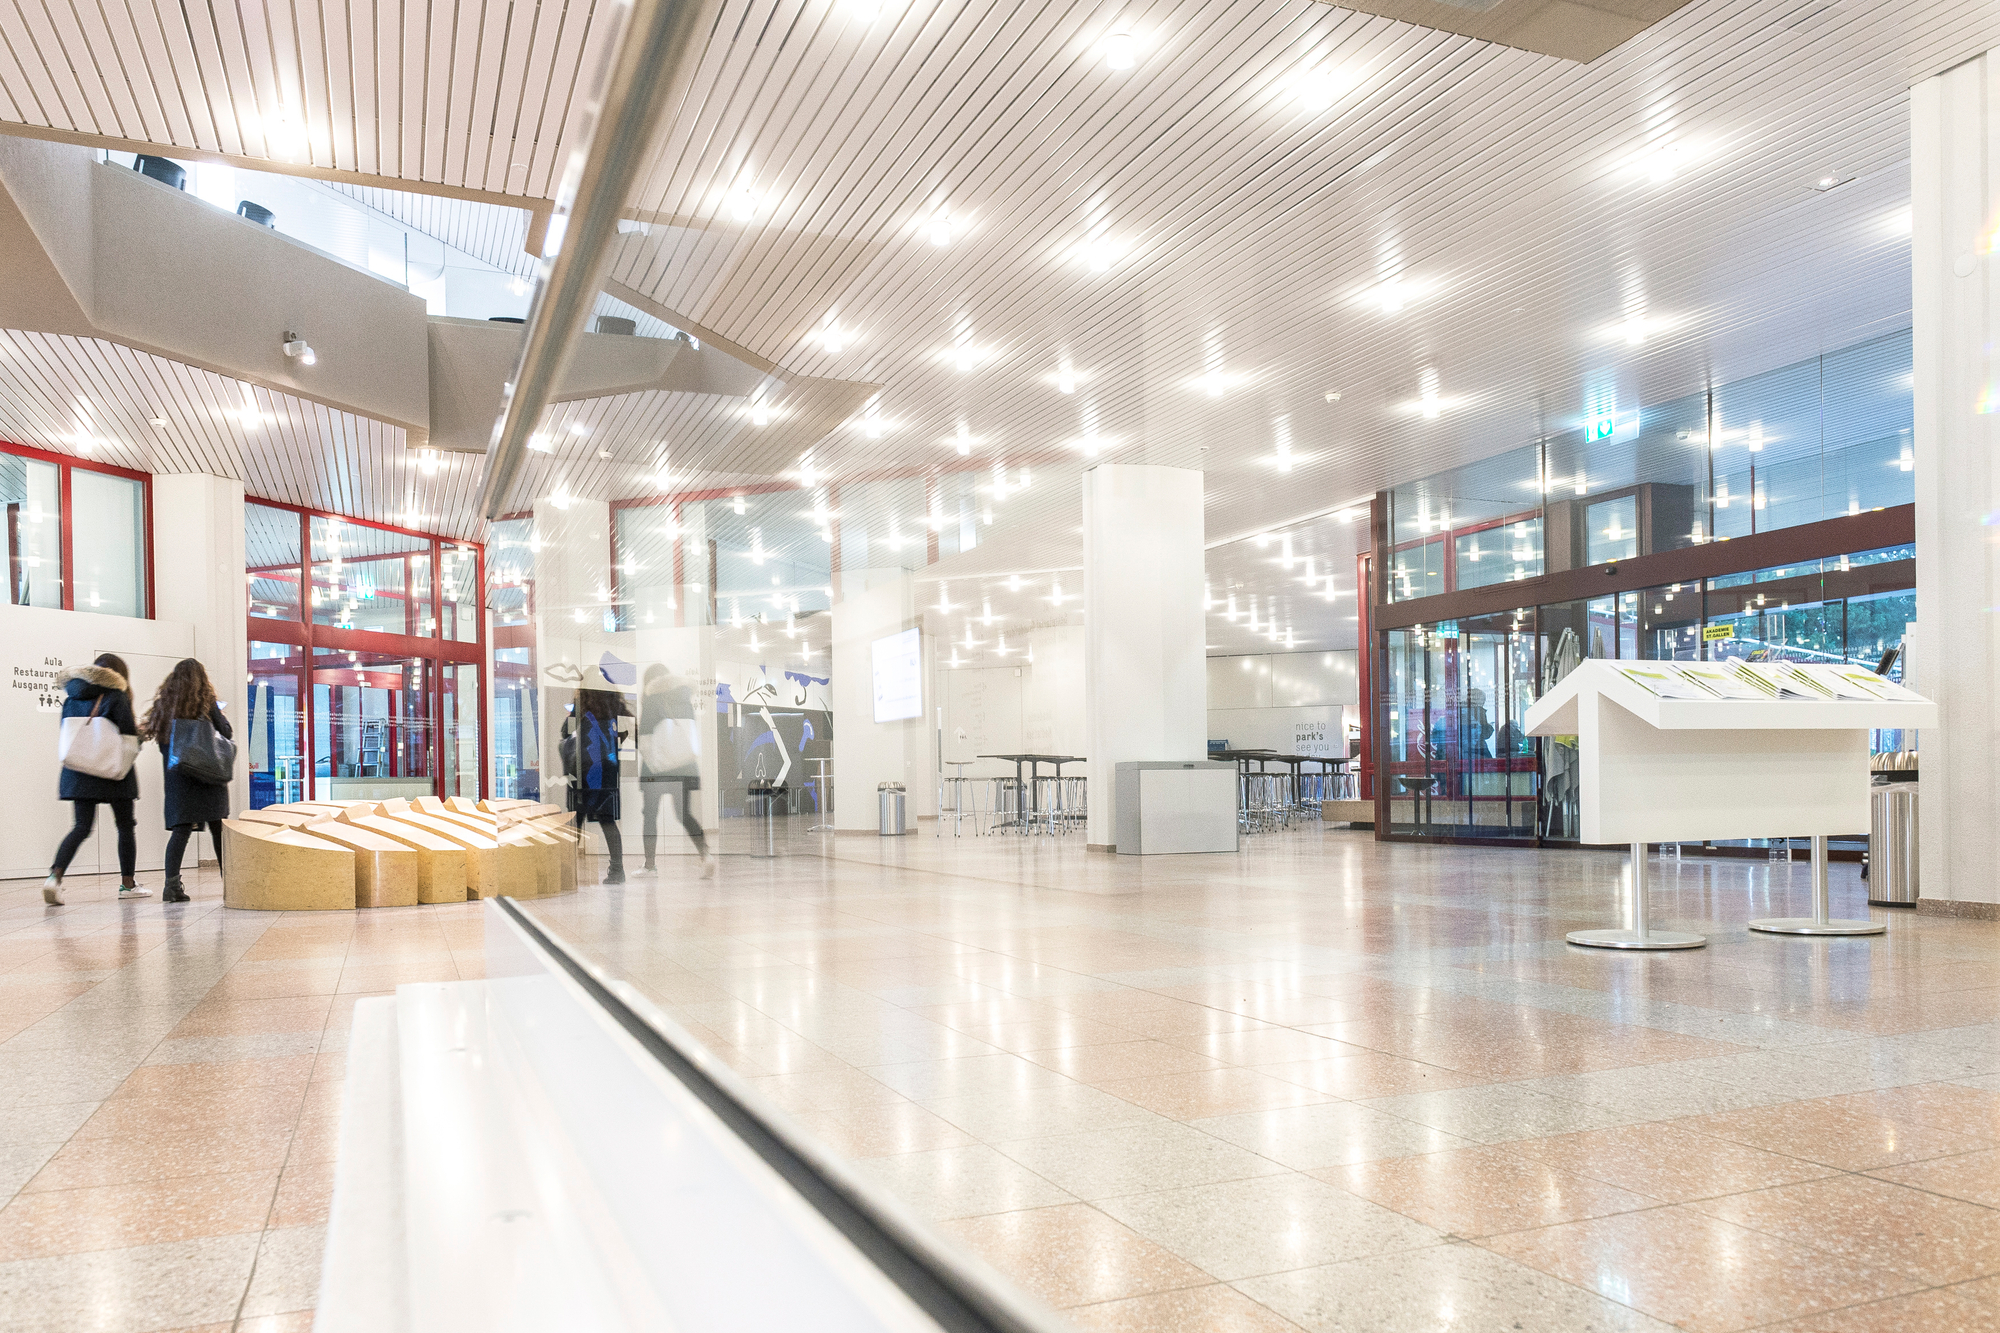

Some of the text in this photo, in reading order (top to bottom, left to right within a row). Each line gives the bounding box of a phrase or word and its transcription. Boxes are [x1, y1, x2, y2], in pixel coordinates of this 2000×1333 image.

[44, 656, 63, 666] Aula
[13, 666, 59, 678] Restauran
[12, 679, 49, 692] Ausgang
[1295, 721, 1326, 730] nice to
[1296, 731, 1324, 743] park's
[1295, 744, 1311, 752] see
[1313, 744, 1329, 753] you
